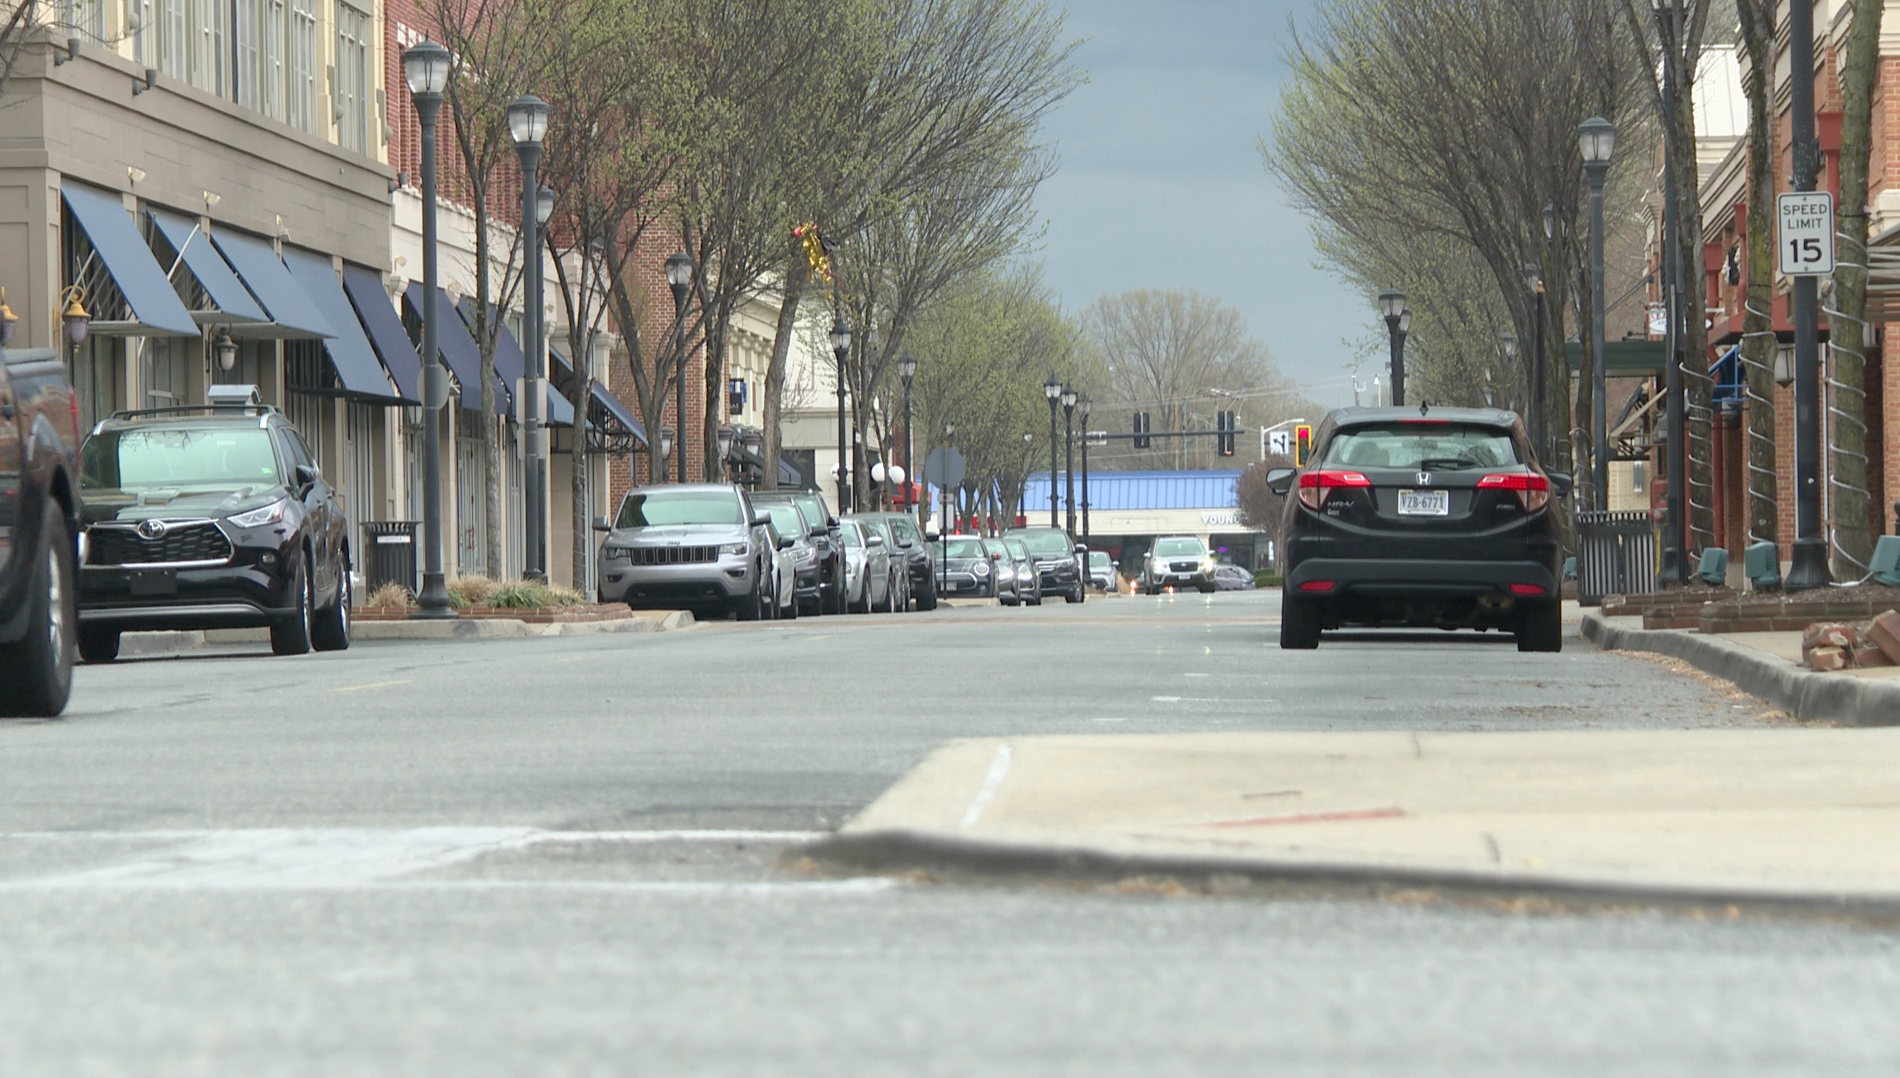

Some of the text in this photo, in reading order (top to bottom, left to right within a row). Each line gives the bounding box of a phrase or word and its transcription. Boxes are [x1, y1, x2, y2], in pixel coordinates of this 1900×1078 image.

[1783, 204, 1828, 216] SPEED
[1788, 218, 1823, 230] LIMIT
[1790, 238, 1822, 264] 15
[1401, 496, 1444, 509] VZB-6771
